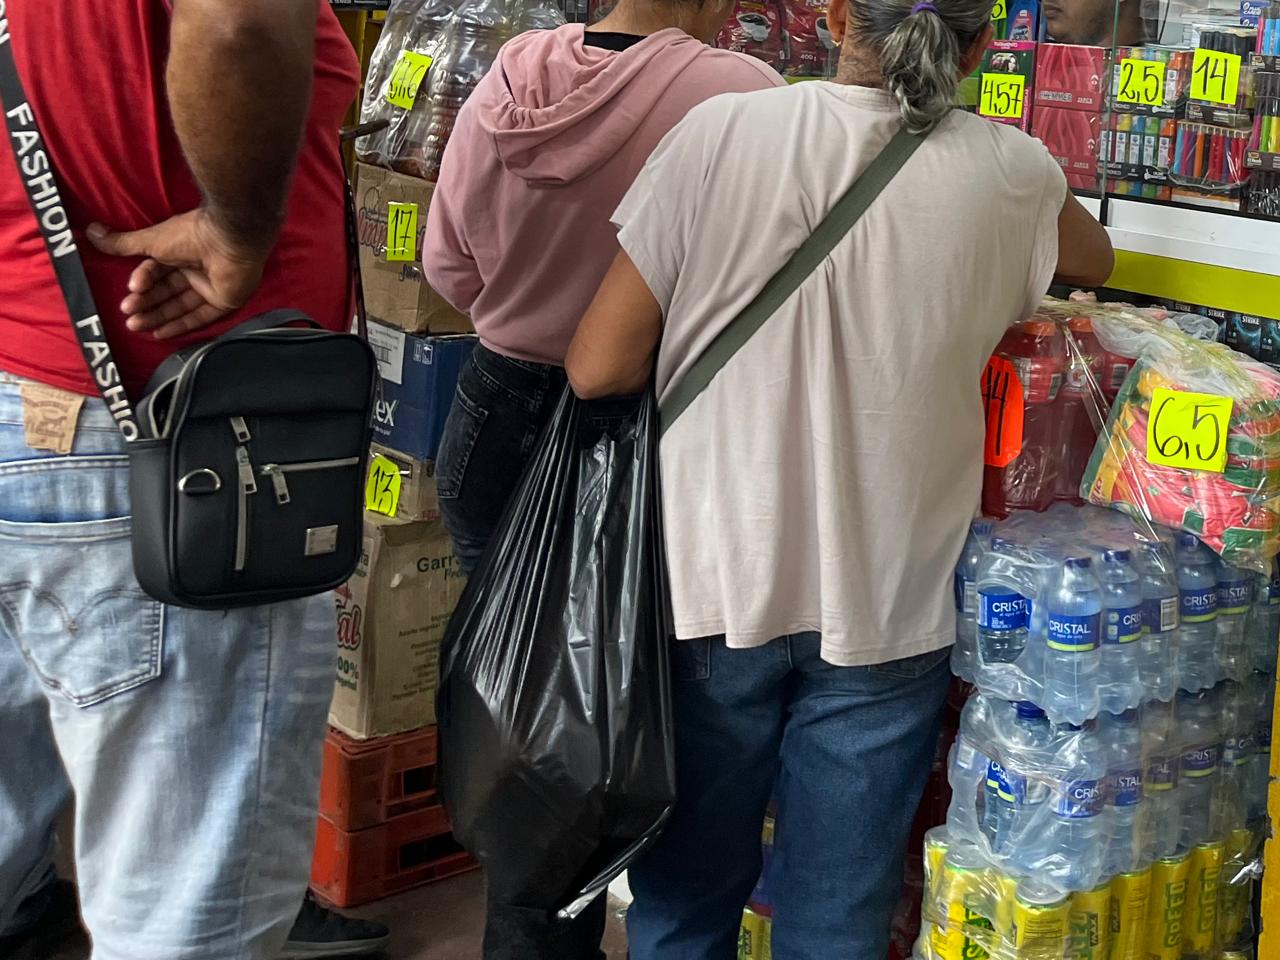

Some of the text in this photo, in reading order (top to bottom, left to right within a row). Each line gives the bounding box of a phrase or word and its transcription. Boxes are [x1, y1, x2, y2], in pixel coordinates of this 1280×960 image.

[983, 79, 1022, 115] 4,57
[1119, 62, 1159, 103] 2,5
[1194, 55, 1230, 100] 14
[6, 101, 76, 259] FASHION
[390, 207, 414, 256] 17
[75, 313, 140, 442] FASHIO
[1152, 396, 1220, 461] 6,5
[1049, 620, 1091, 635] CRISTAL
